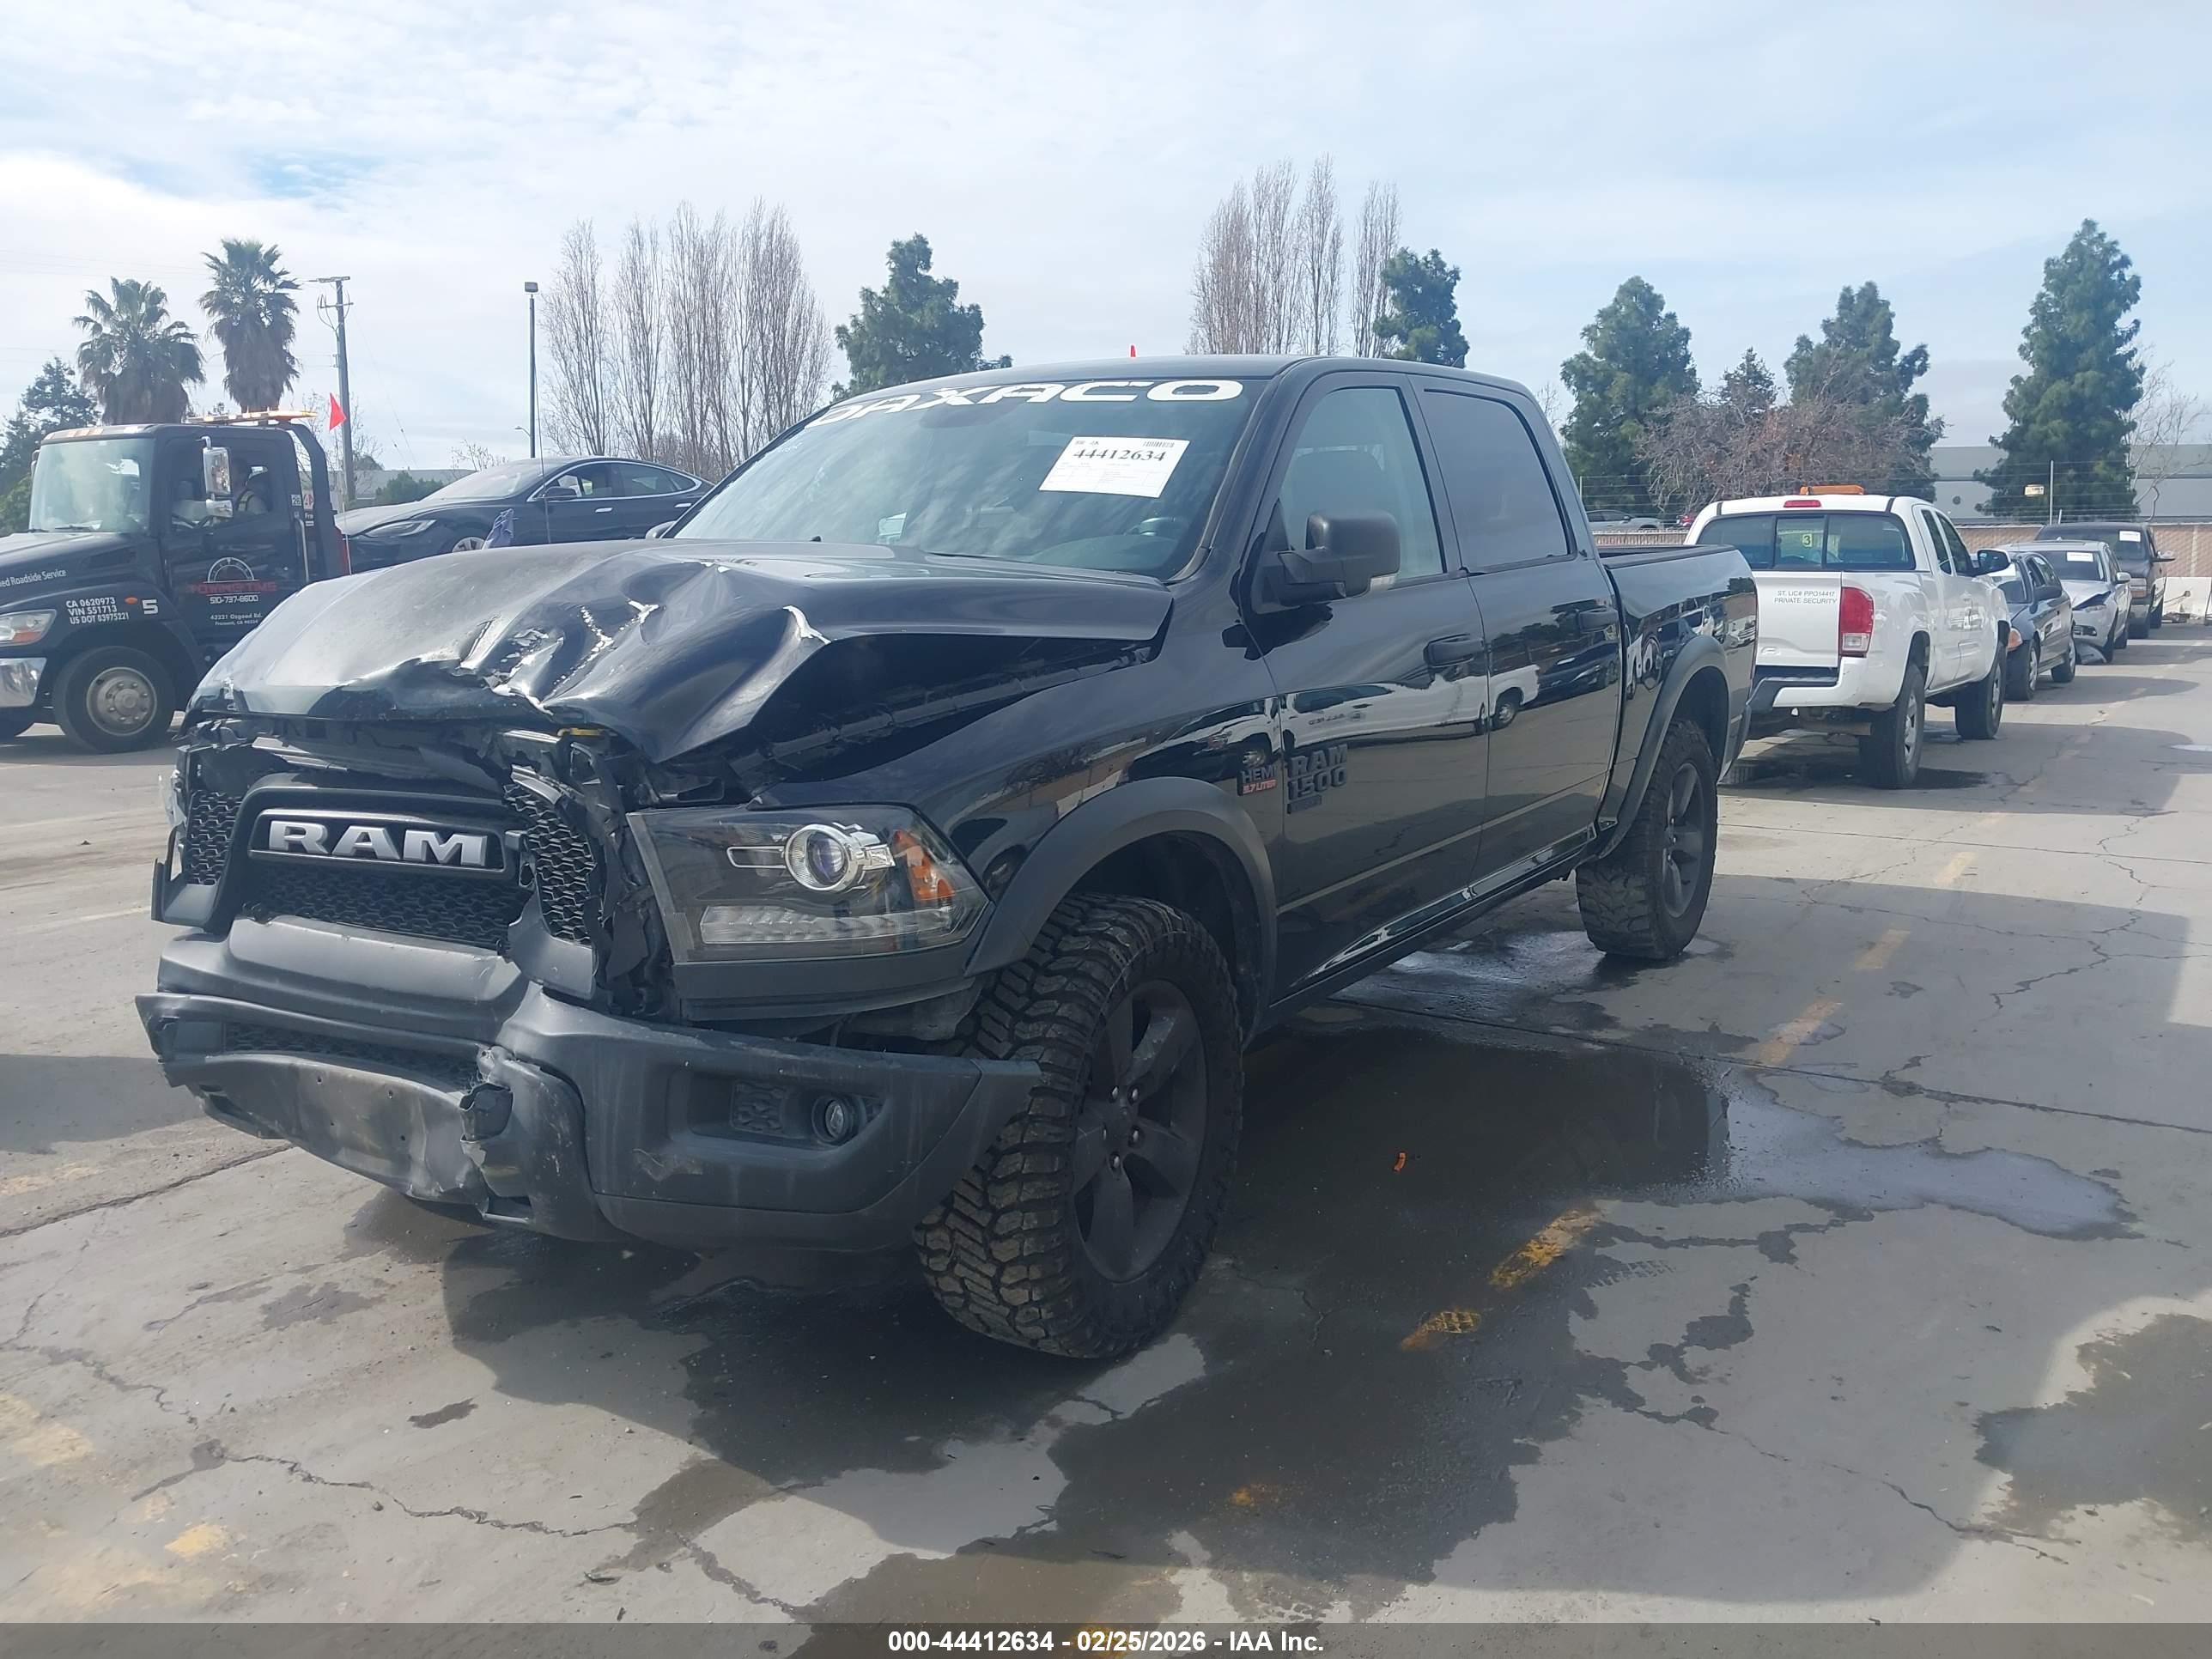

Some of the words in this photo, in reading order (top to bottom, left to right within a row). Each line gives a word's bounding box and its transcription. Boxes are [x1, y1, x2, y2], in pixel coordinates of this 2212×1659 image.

[1073, 449, 1166, 461] 44412634
[1803, 535, 1811, 545] 3
[10, 572, 42, 586] Roadside
[42, 568, 67, 580] Service
[80, 597, 116, 607] 0620973
[142, 599, 159, 615] 5
[210, 595, 258, 605] 510-737-8600
[1290, 744, 1348, 777] RAM
[1242, 764, 1276, 783] HEMI
[1256, 779, 1277, 791] LITER
[1288, 767, 1347, 799] 1500
[269, 820, 488, 866] RAM
